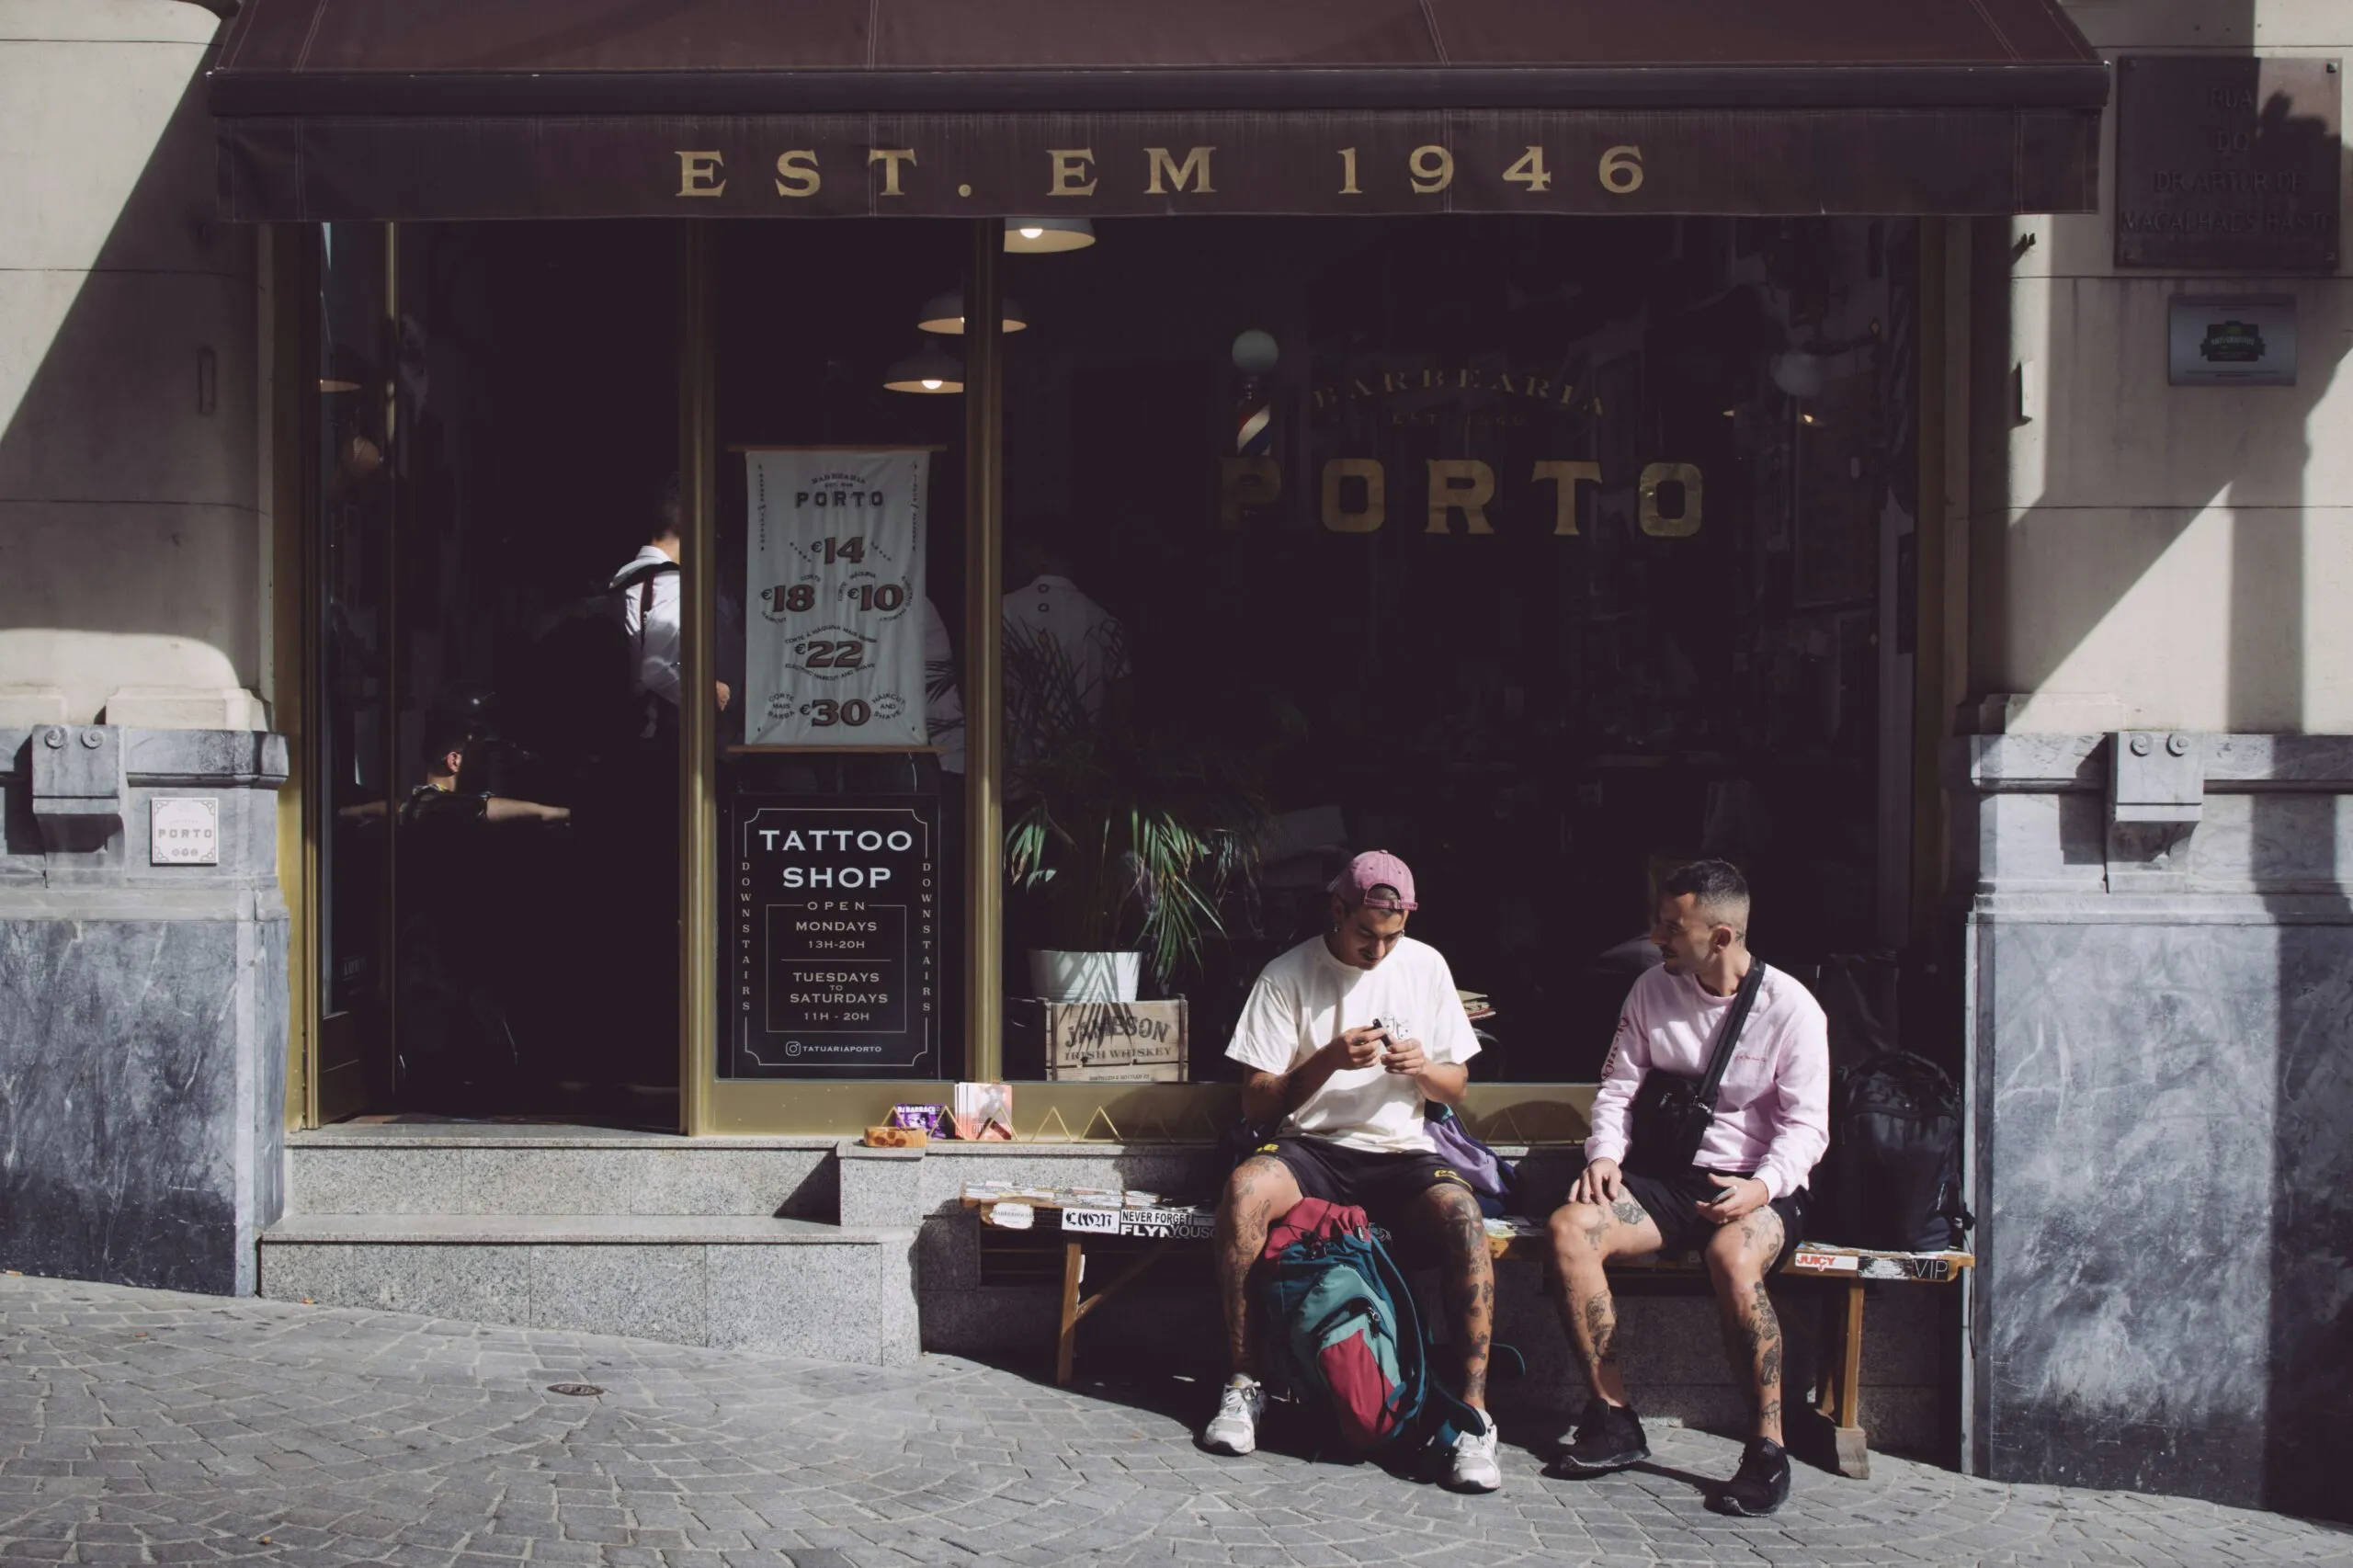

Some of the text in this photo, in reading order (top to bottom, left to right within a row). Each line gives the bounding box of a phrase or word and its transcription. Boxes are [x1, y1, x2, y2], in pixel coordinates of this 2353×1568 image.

[2208, 86, 2254, 109] RUA
[2215, 131, 2250, 153] DO
[676, 144, 1644, 198] EST. EM 1946
[2193, 170, 2268, 193] ARTUR
[2275, 169, 2306, 193] DE
[1312, 368, 1605, 416] BARBEARIA
[794, 491, 884, 508] PORTO
[1220, 457, 1703, 538] PORTO
[810, 536, 866, 565] €14
[761, 584, 815, 613] €18
[847, 584, 904, 612] €10
[794, 641, 863, 668] €22
[768, 693, 795, 702] CORTE
[871, 692, 906, 705] HAIRCUT
[799, 699, 871, 728] €30
[873, 710, 902, 721] SHAVE
[157, 828, 212, 839] PORTO
[758, 829, 913, 852] TATTOO
[783, 867, 892, 889] SHOP
[807, 901, 866, 911] OPEN
[740, 862, 752, 1011] DOWNSTAIRS
[796, 921, 878, 931] MONDAYS
[808, 940, 865, 949] 13H-20H
[921, 863, 932, 1012] DOWNSTAIRS
[793, 972, 880, 983] TUESDAYS
[790, 994, 889, 1004] SATURDAYS
[804, 1012, 829, 1021] 11H
[843, 1012, 870, 1021] 20H
[1064, 1047, 1172, 1061] IRISH WHISKEY
[1122, 1210, 1152, 1223] NEVER
[1797, 1256, 1836, 1267] JUICY
[1914, 1259, 1949, 1279] VIP
